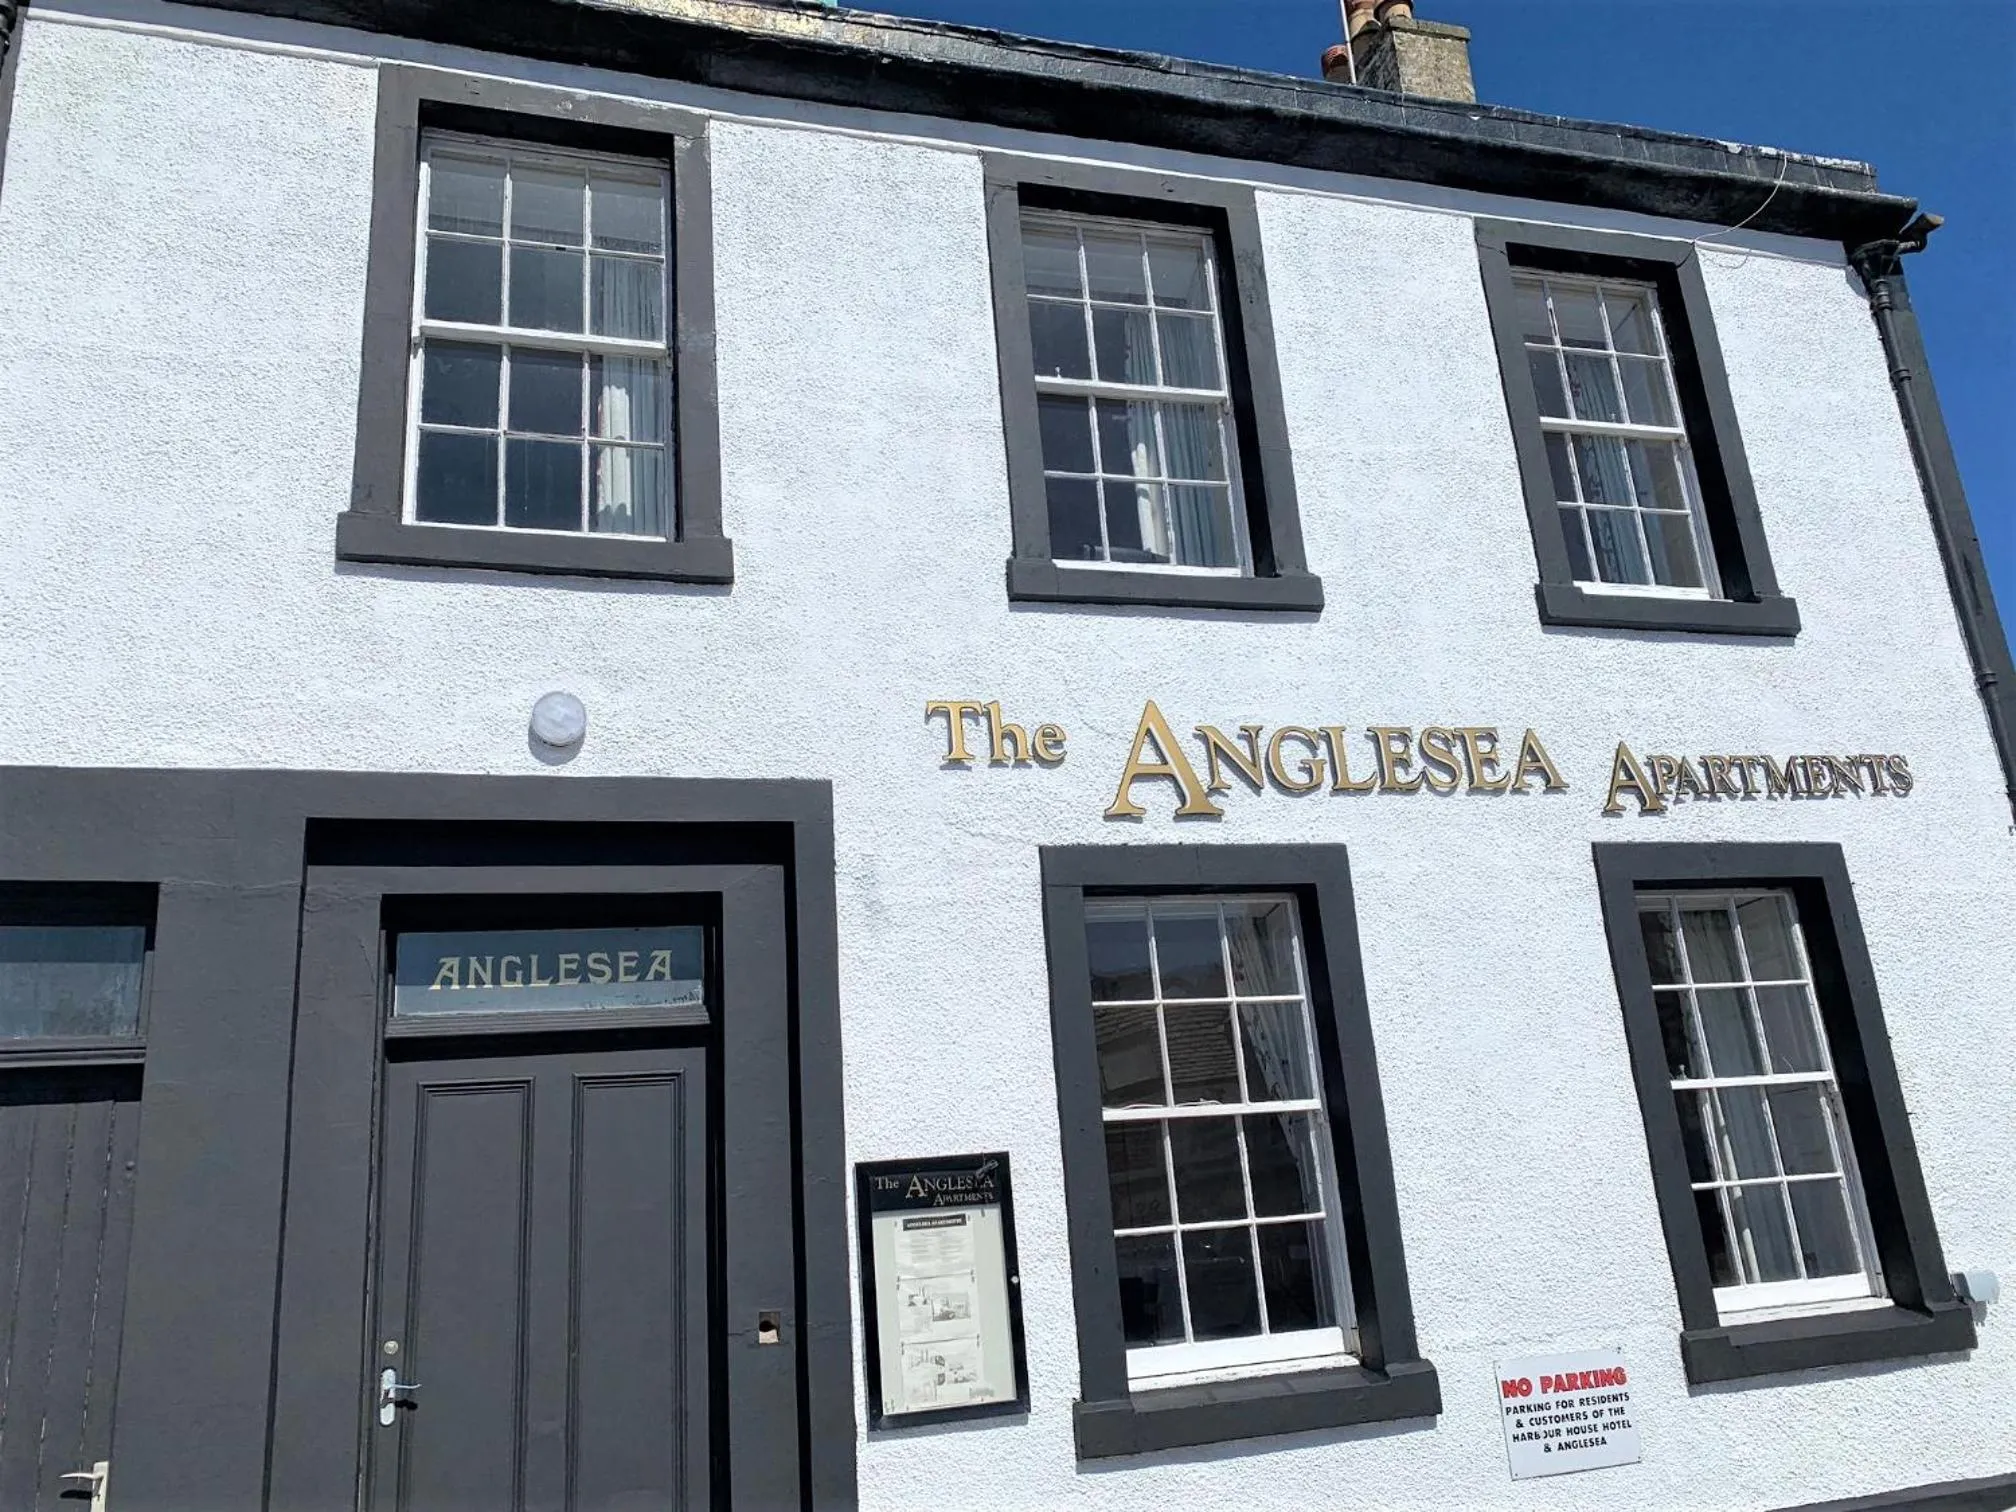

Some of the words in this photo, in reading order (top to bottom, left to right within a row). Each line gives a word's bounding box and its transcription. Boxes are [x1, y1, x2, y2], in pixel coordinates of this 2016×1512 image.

[925, 699, 1069, 768] The
[1104, 700, 1570, 820] ANGLESEA
[1602, 740, 1915, 816] APARTMENTS
[428, 950, 673, 990] ANGLESEA
[875, 1177, 899, 1190] The
[905, 1174, 995, 1199] ANGLESA
[1501, 1377, 1533, 1399] NO
[1539, 1366, 1628, 1395] PARKING
[1505, 1402, 1552, 1416] PARKING
[1555, 1399, 1575, 1410] FOR
[1579, 1392, 1630, 1407] RESIDENTS
[1515, 1419, 1524, 1429] &
[1529, 1411, 1588, 1427] CUSTOMERS
[1592, 1409, 1604, 1419] OF
[1608, 1406, 1626, 1416] THE
[1566, 1425, 1599, 1436] HOUSE
[1602, 1419, 1633, 1432] HOTEL
[1543, 1443, 1552, 1453] &
[1557, 1436, 1608, 1452] ANGLESEA
